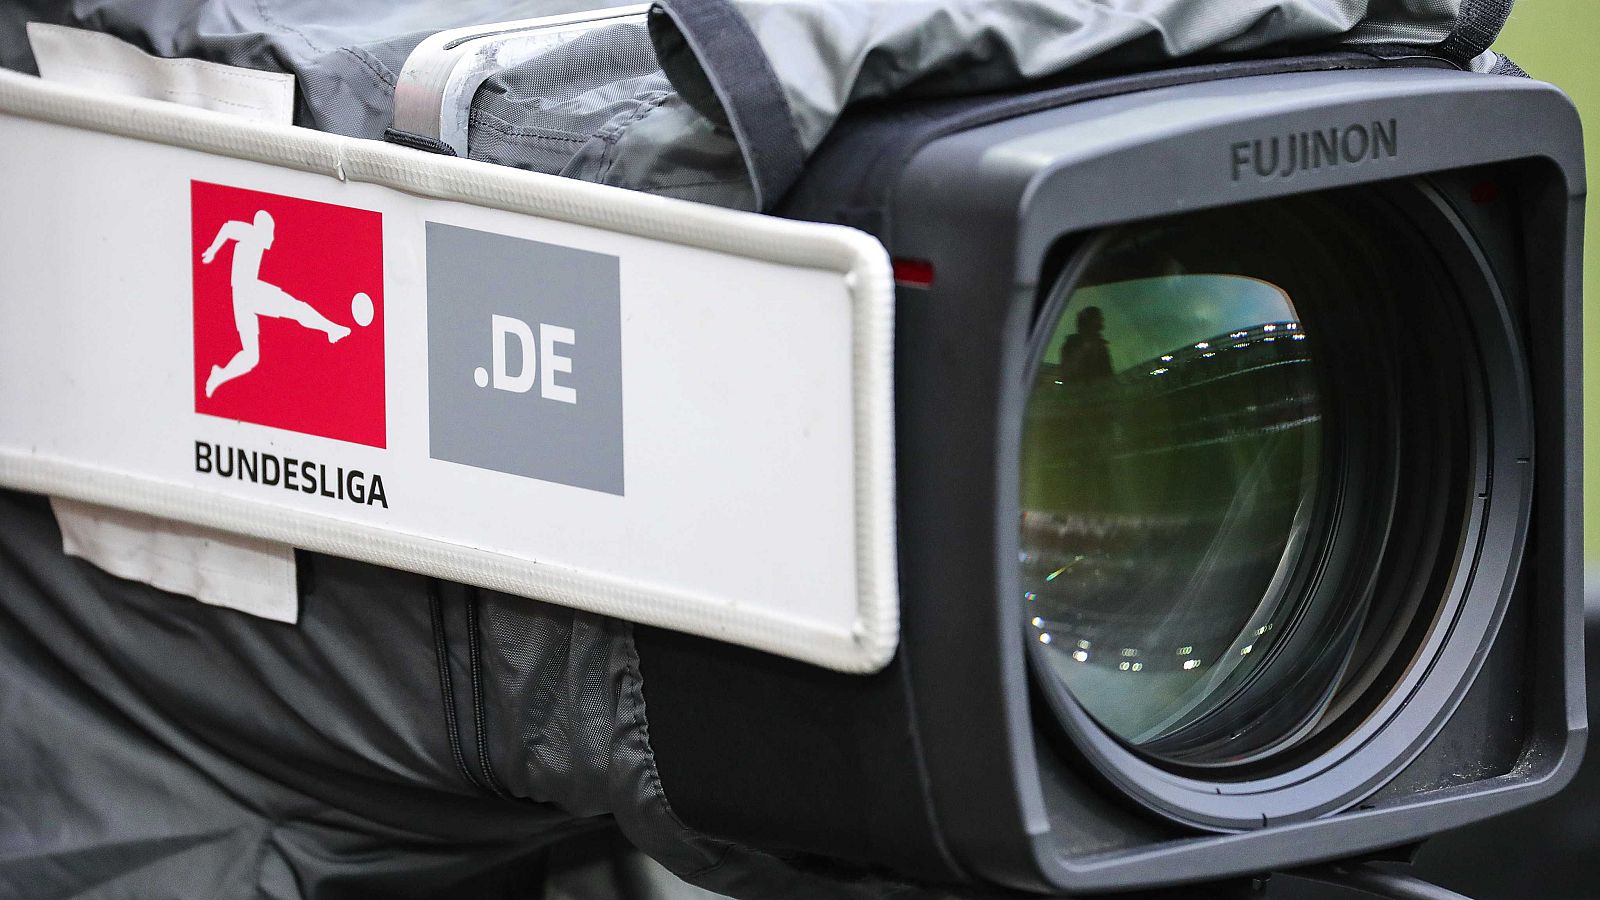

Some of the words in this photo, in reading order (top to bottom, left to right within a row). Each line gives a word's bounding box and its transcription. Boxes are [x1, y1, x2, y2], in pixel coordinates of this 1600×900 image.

[1231, 118, 1397, 181] FUJINON
[474, 314, 576, 404] .DE
[195, 440, 388, 509] BUNDESLIGA
